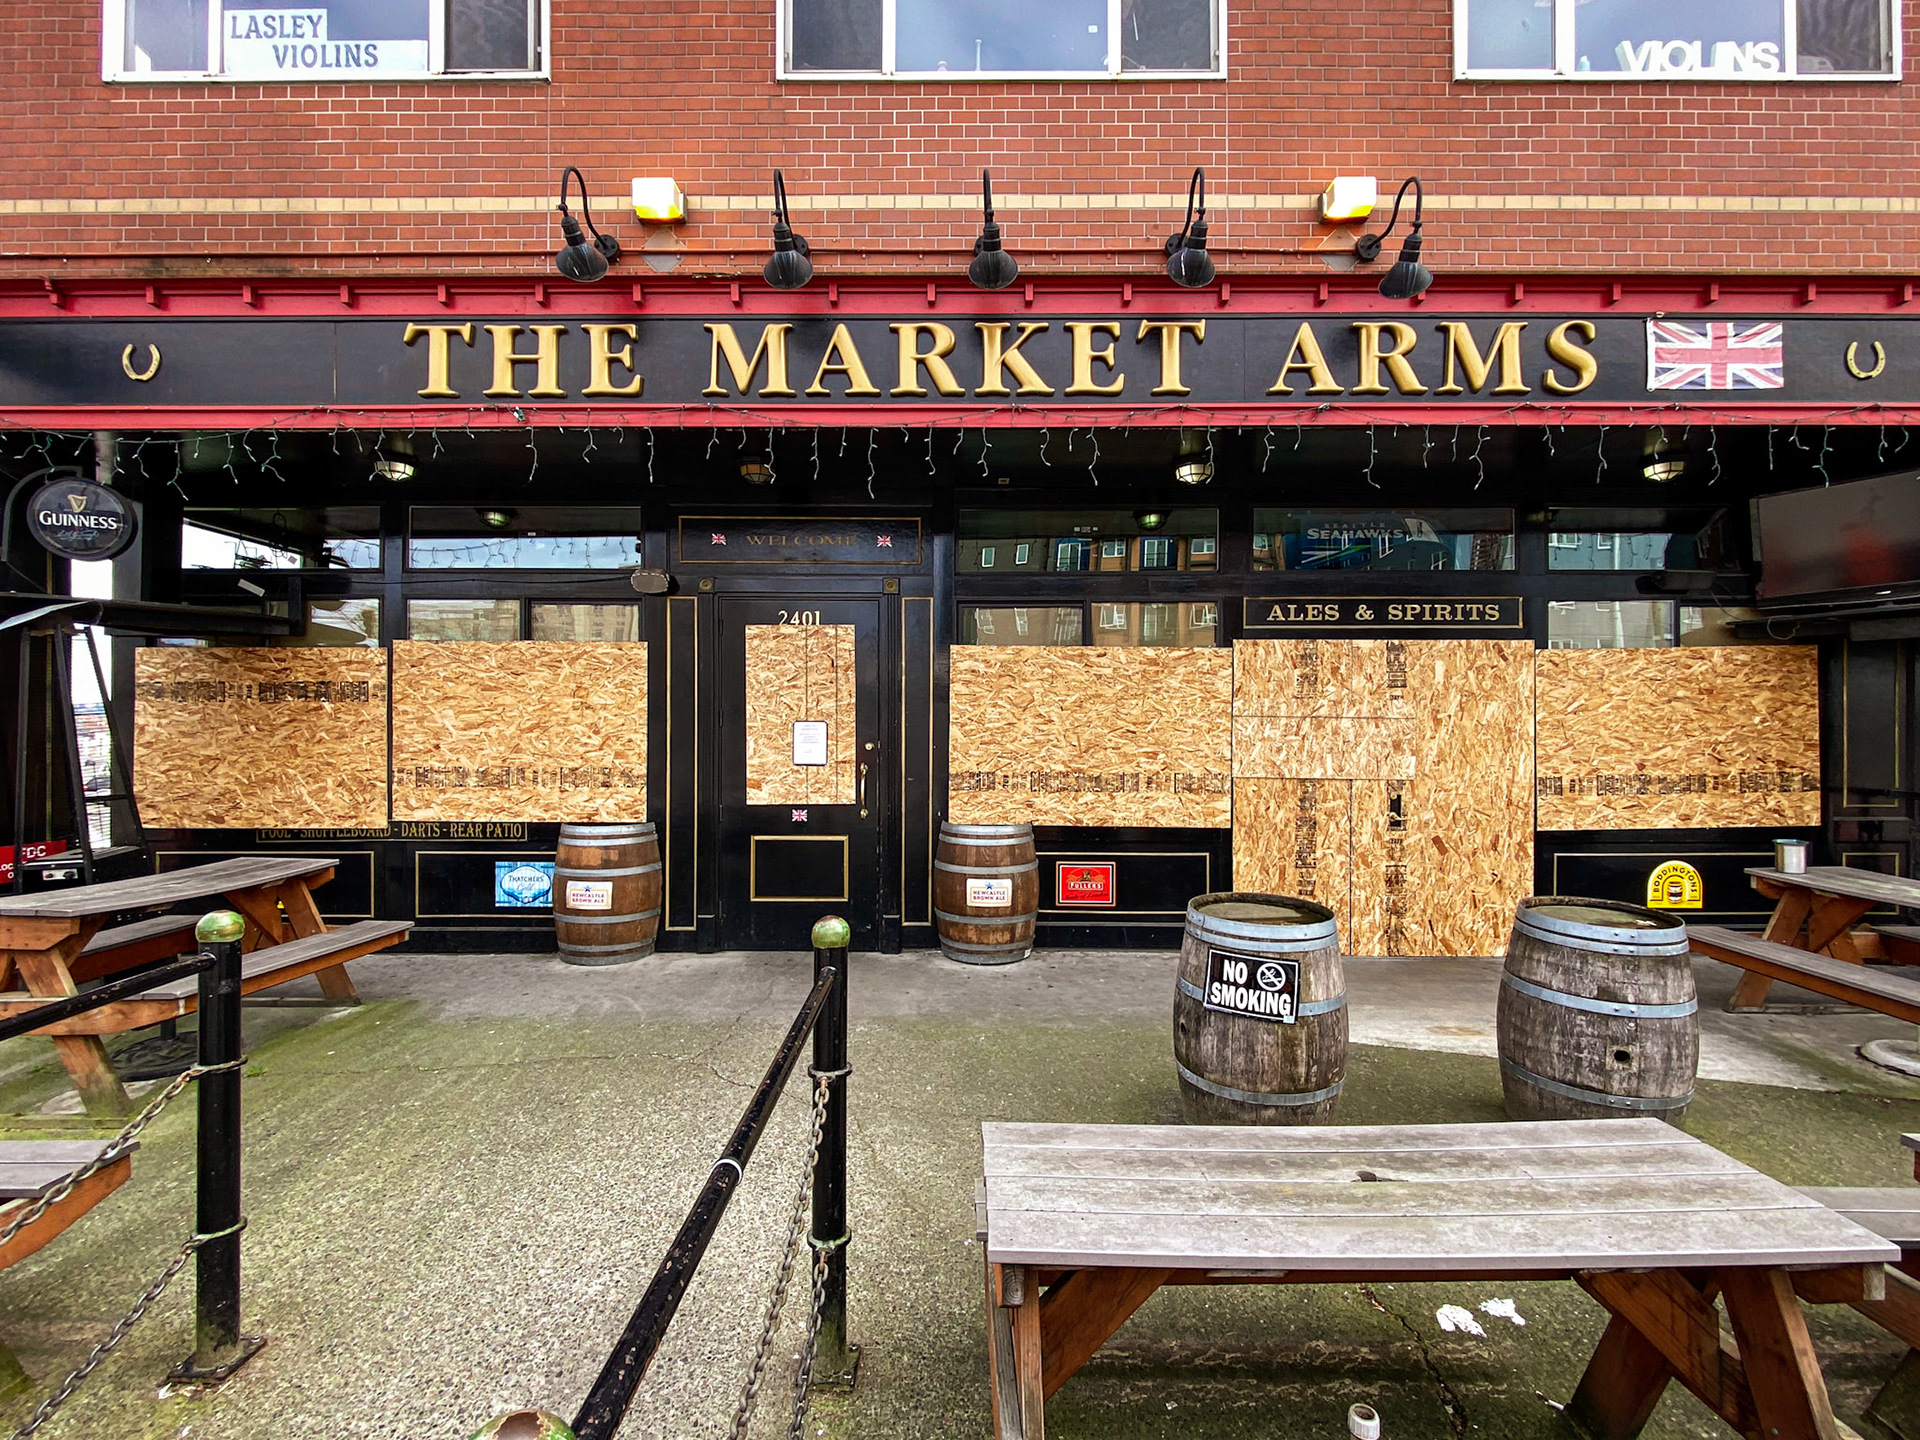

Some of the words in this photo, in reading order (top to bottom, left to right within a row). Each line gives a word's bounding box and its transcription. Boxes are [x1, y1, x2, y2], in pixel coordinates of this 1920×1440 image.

[231, 15, 323, 39] LASLEY
[272, 44, 379, 68] VIOLINS
[1615, 40, 1780, 73] VIOLINS
[403, 322, 644, 398] THE
[702, 319, 1206, 397] MARKET
[1266, 320, 1598, 396] ARMS
[39, 510, 118, 530] GUINNESS
[746, 535, 859, 546] WELCOME
[1307, 528, 1404, 540] SEAHAWKS
[778, 610, 820, 626] 2401
[1266, 604, 1340, 621] ALES
[1354, 605, 1375, 621] &
[1388, 604, 1501, 621] SPIRITS
[401, 822, 440, 837] DARTS
[450, 822, 482, 837] REAR
[486, 822, 522, 837] PATIO
[1653, 866, 1697, 892] BODDINGTONS
[1223, 959, 1248, 985] NO
[1210, 981, 1292, 1016] SMOKING
